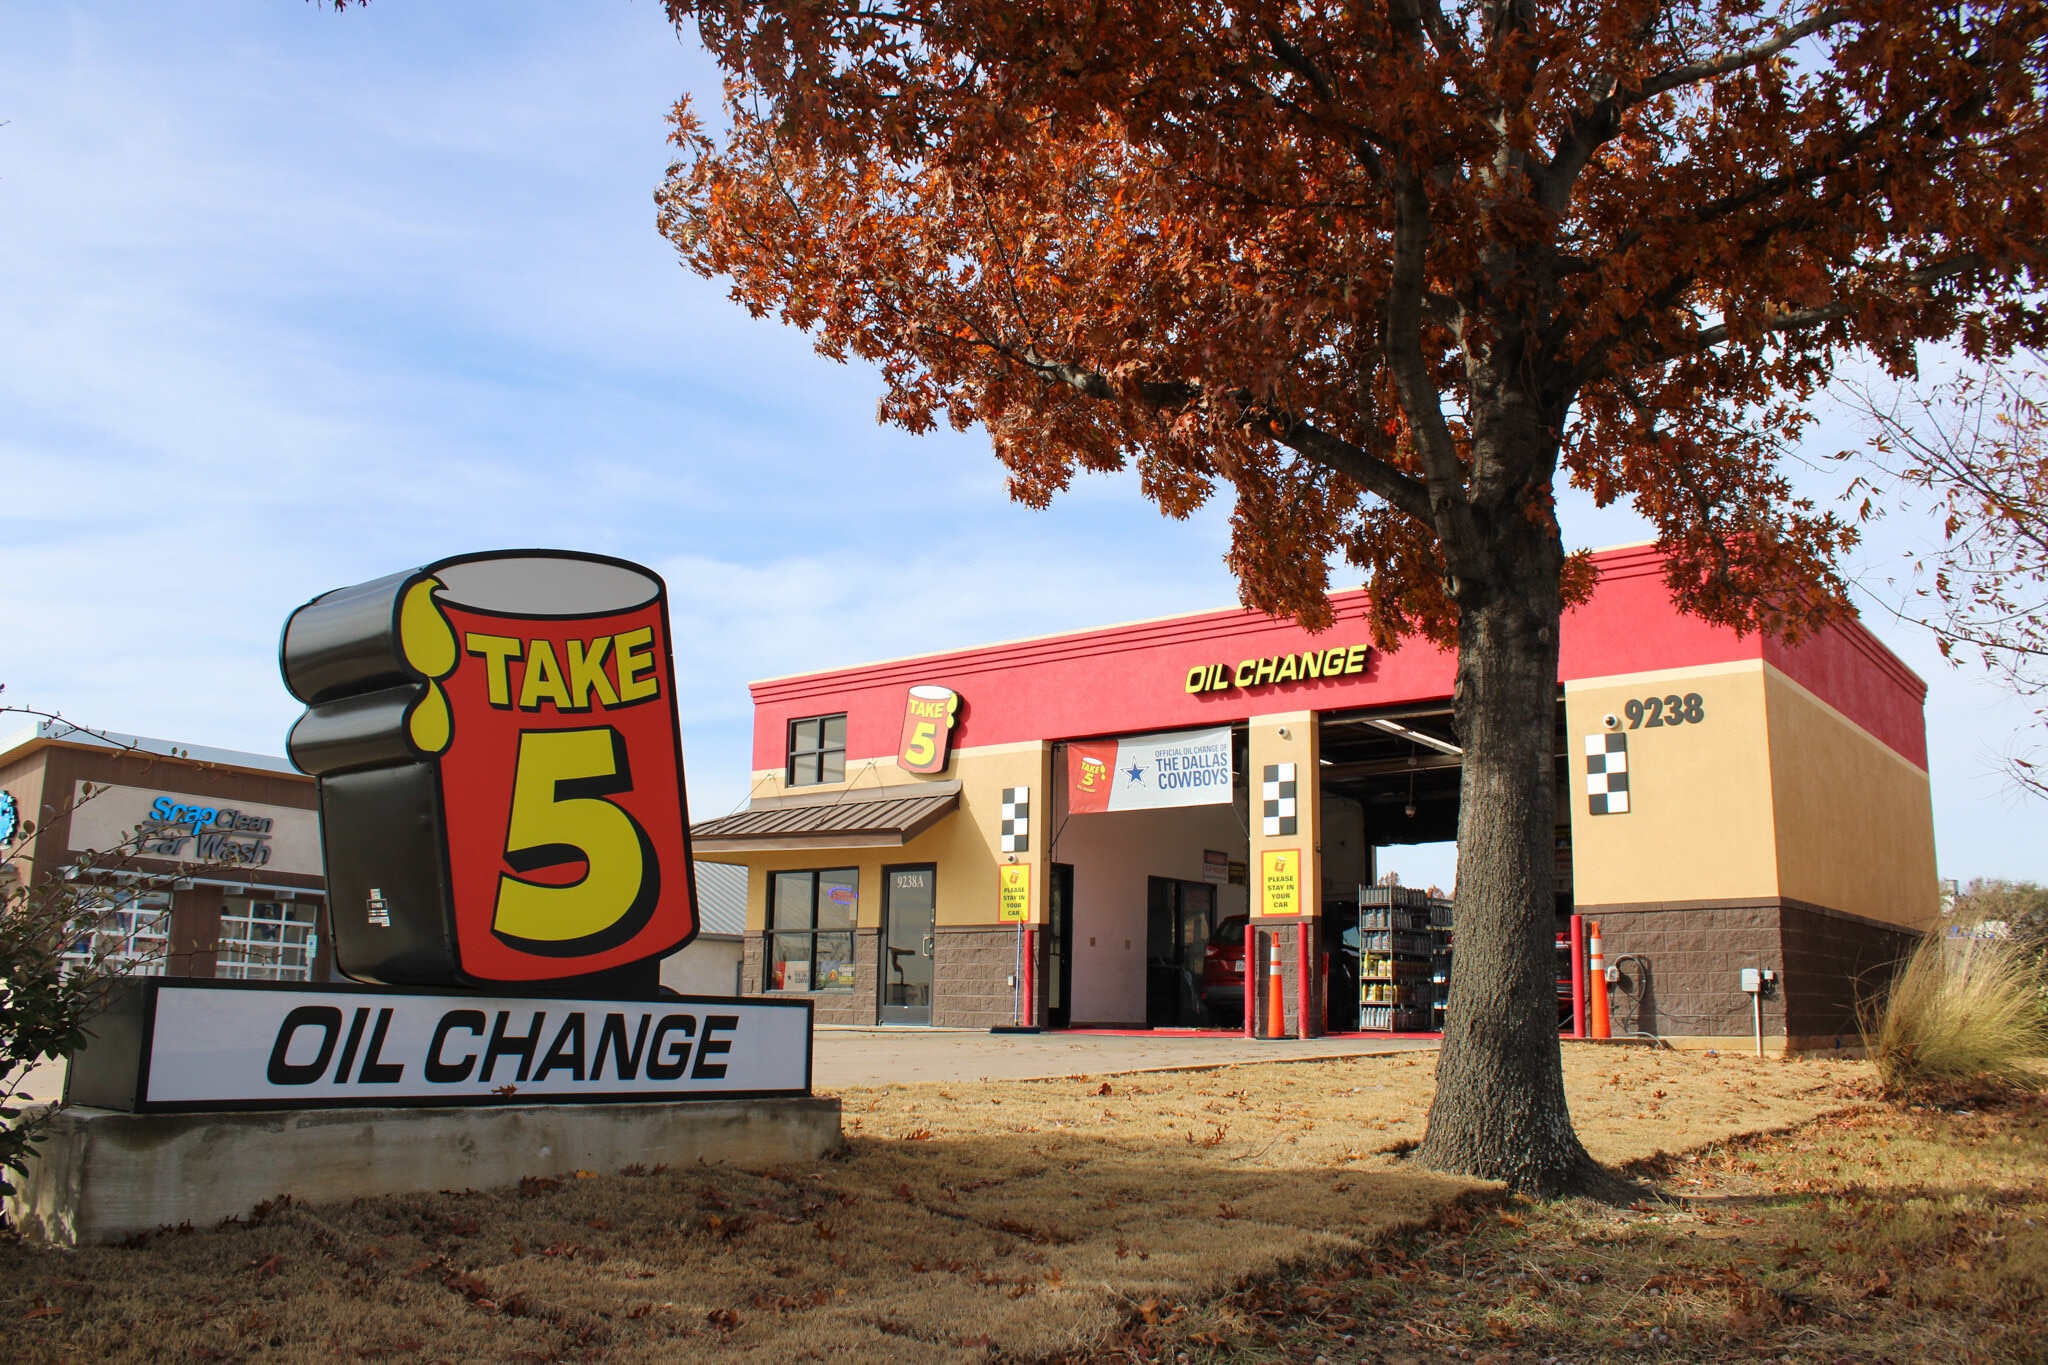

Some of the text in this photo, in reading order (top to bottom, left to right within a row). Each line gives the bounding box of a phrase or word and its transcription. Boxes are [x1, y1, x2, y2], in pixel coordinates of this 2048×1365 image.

[464, 626, 659, 712] TAKE
[1184, 643, 1368, 694] OIL CHANGE
[909, 698, 944, 719] TAKE
[1624, 692, 1704, 730] 9238
[904, 721, 936, 768] 5
[1155, 743, 1228, 758] OFFICIAL OIL CHANGE OF
[1081, 761, 1101, 775] TAKE
[1155, 752, 1228, 772] THE DALLAS
[1081, 772, 1095, 786] 5
[1158, 768, 1229, 790] COWBOYS
[196, 833, 273, 864] Wash
[492, 727, 654, 952] 5
[897, 875, 924, 888] 9238A
[830, 891, 855, 901] OPEN
[266, 1005, 739, 1086] OIL CHANGE
